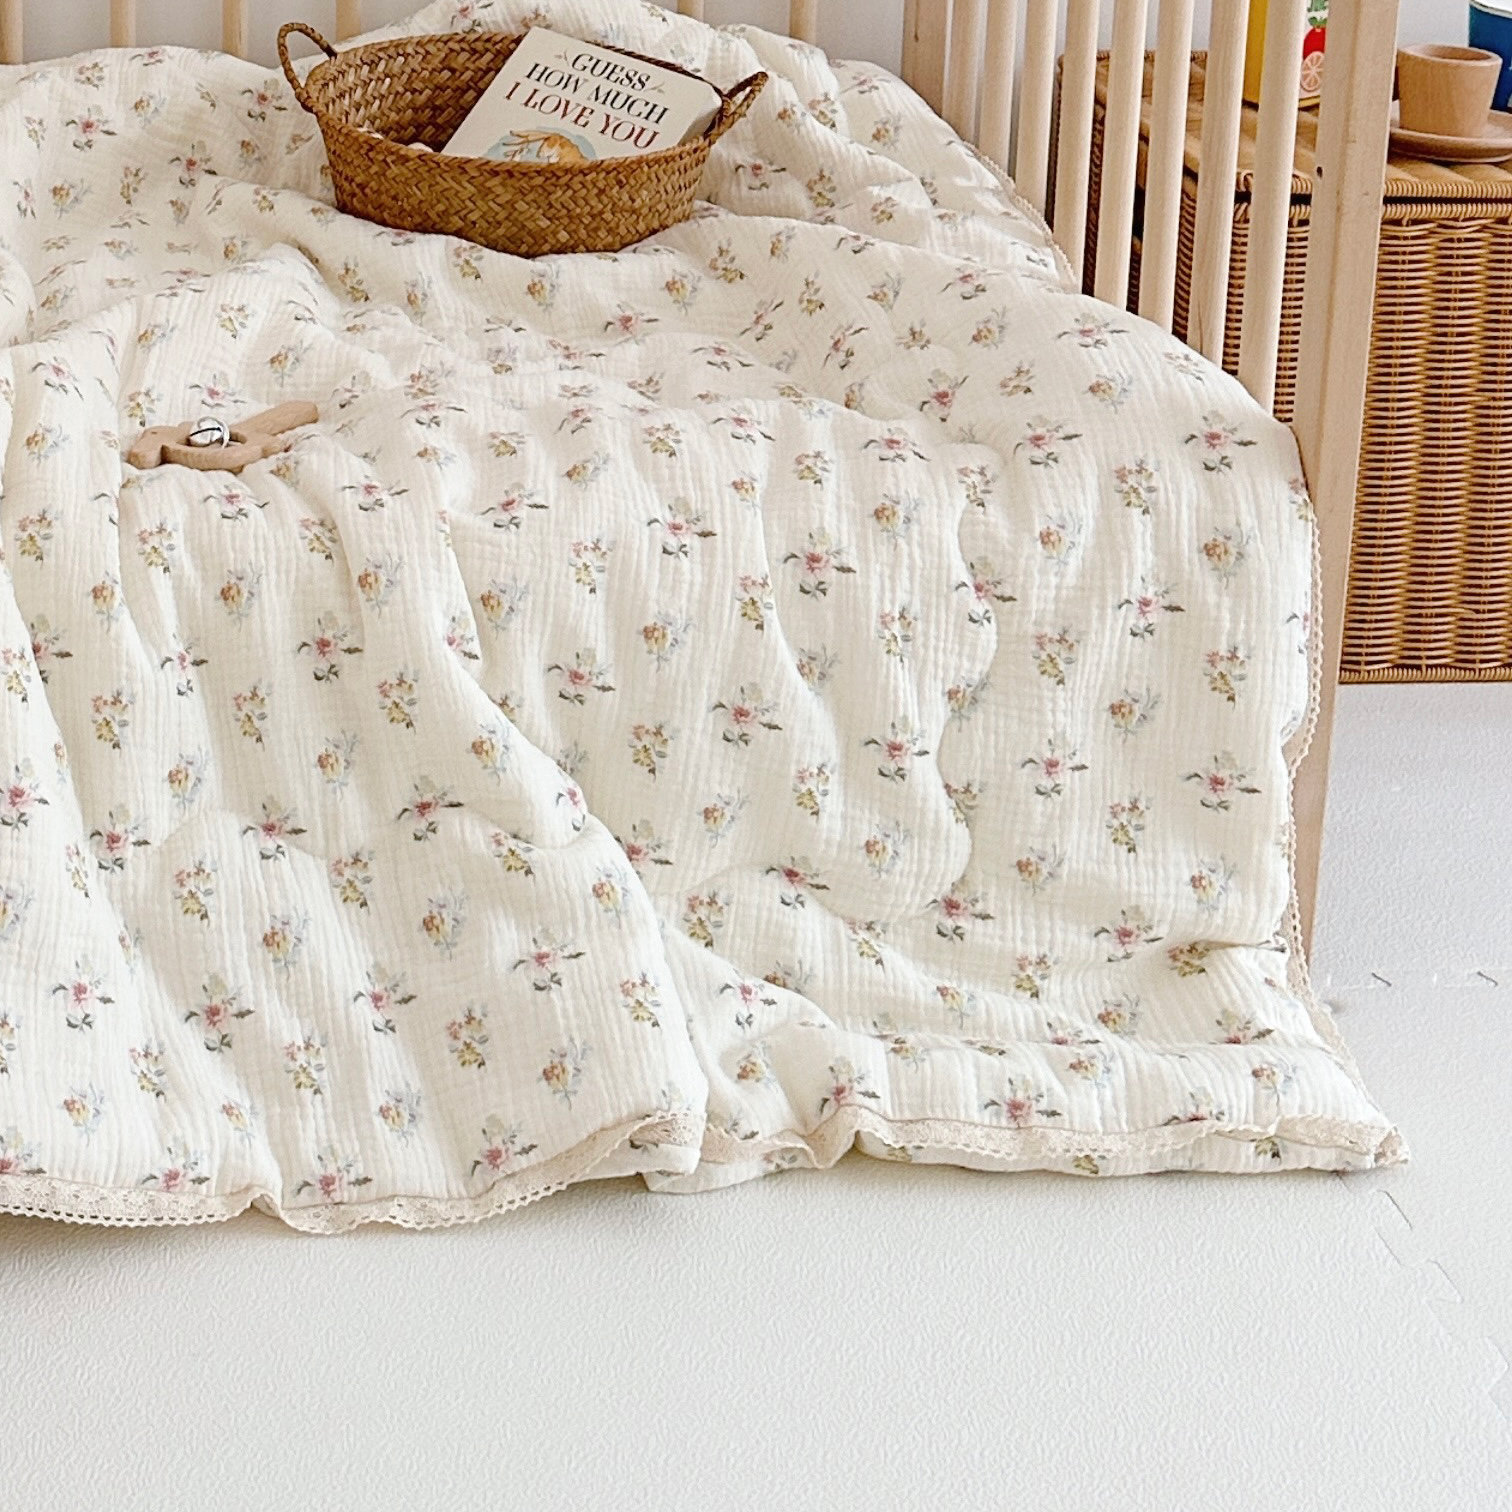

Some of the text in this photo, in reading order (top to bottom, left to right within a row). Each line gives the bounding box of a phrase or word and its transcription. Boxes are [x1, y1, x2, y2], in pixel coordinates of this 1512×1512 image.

[525, 63, 669, 124] HOW MUCH
[571, 53, 651, 91] GUESS
[505, 81, 660, 149] I LOVE YOU
